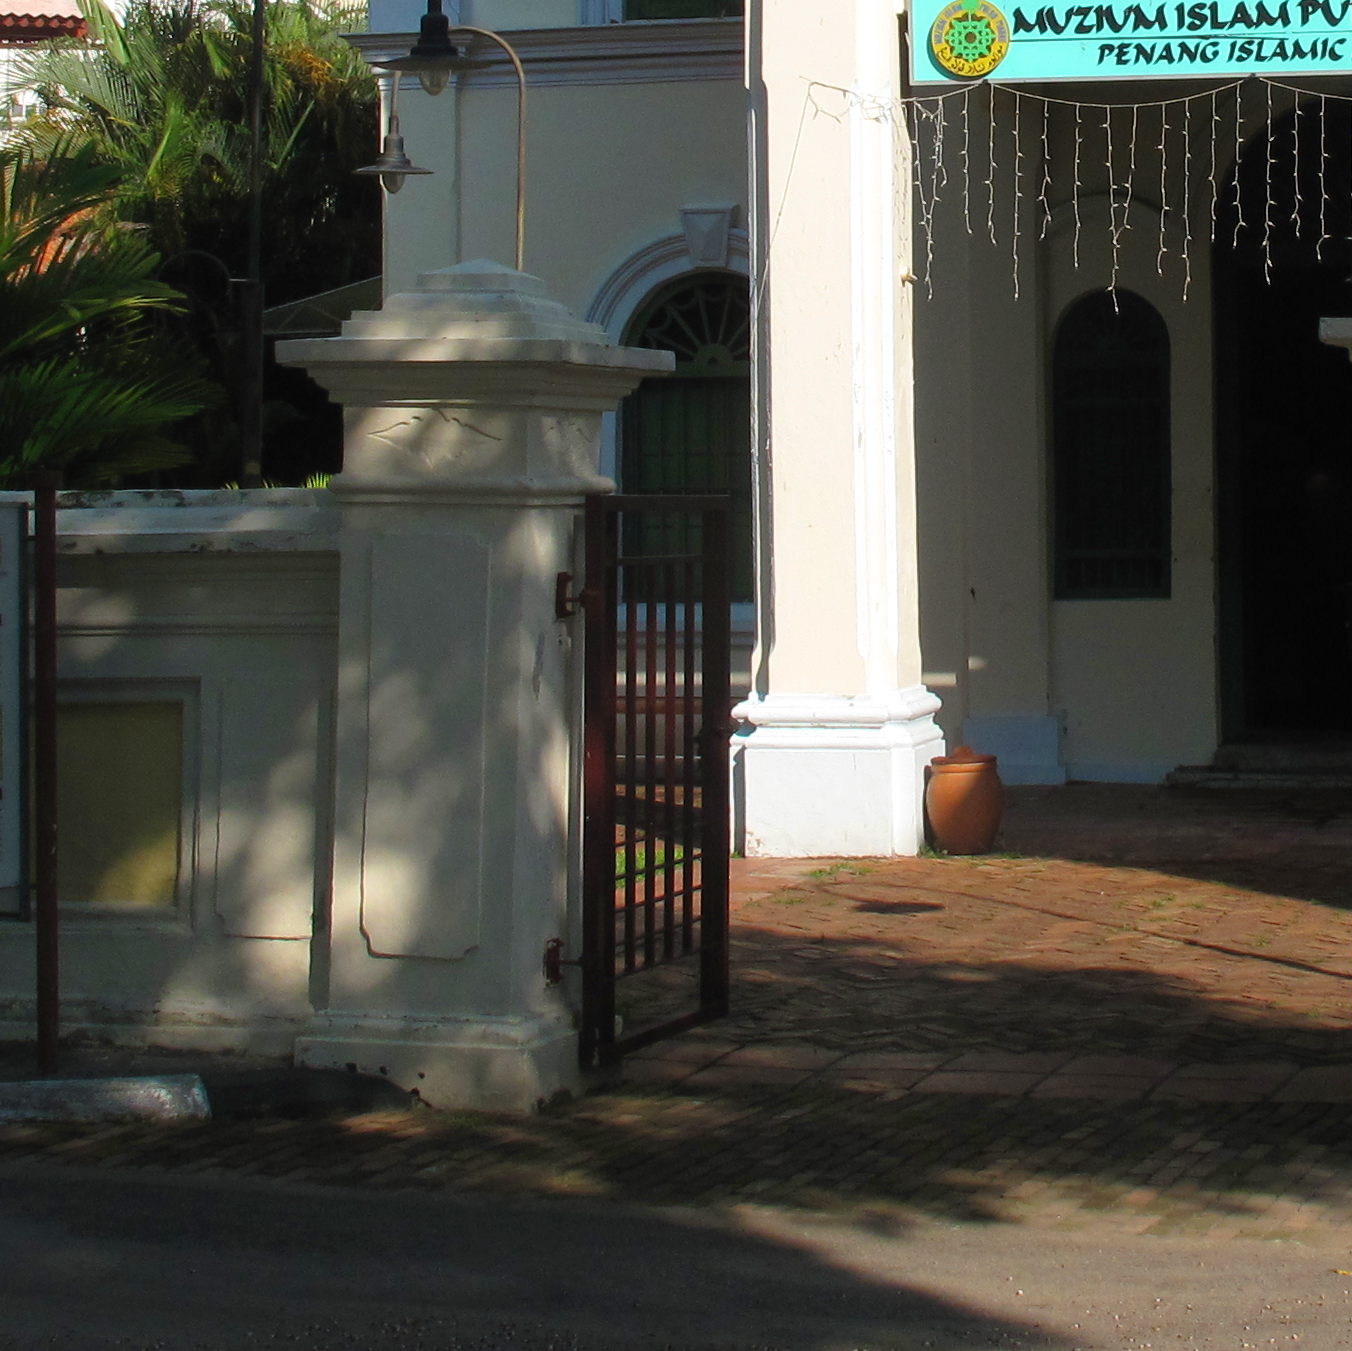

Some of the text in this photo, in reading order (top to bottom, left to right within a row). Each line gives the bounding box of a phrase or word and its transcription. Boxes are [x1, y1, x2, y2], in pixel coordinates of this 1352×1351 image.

[1012, 2, 1168, 35] MUZIUM
[1097, 41, 1220, 66] PENANG
[1227, 37, 1347, 63] ISLAMIC
